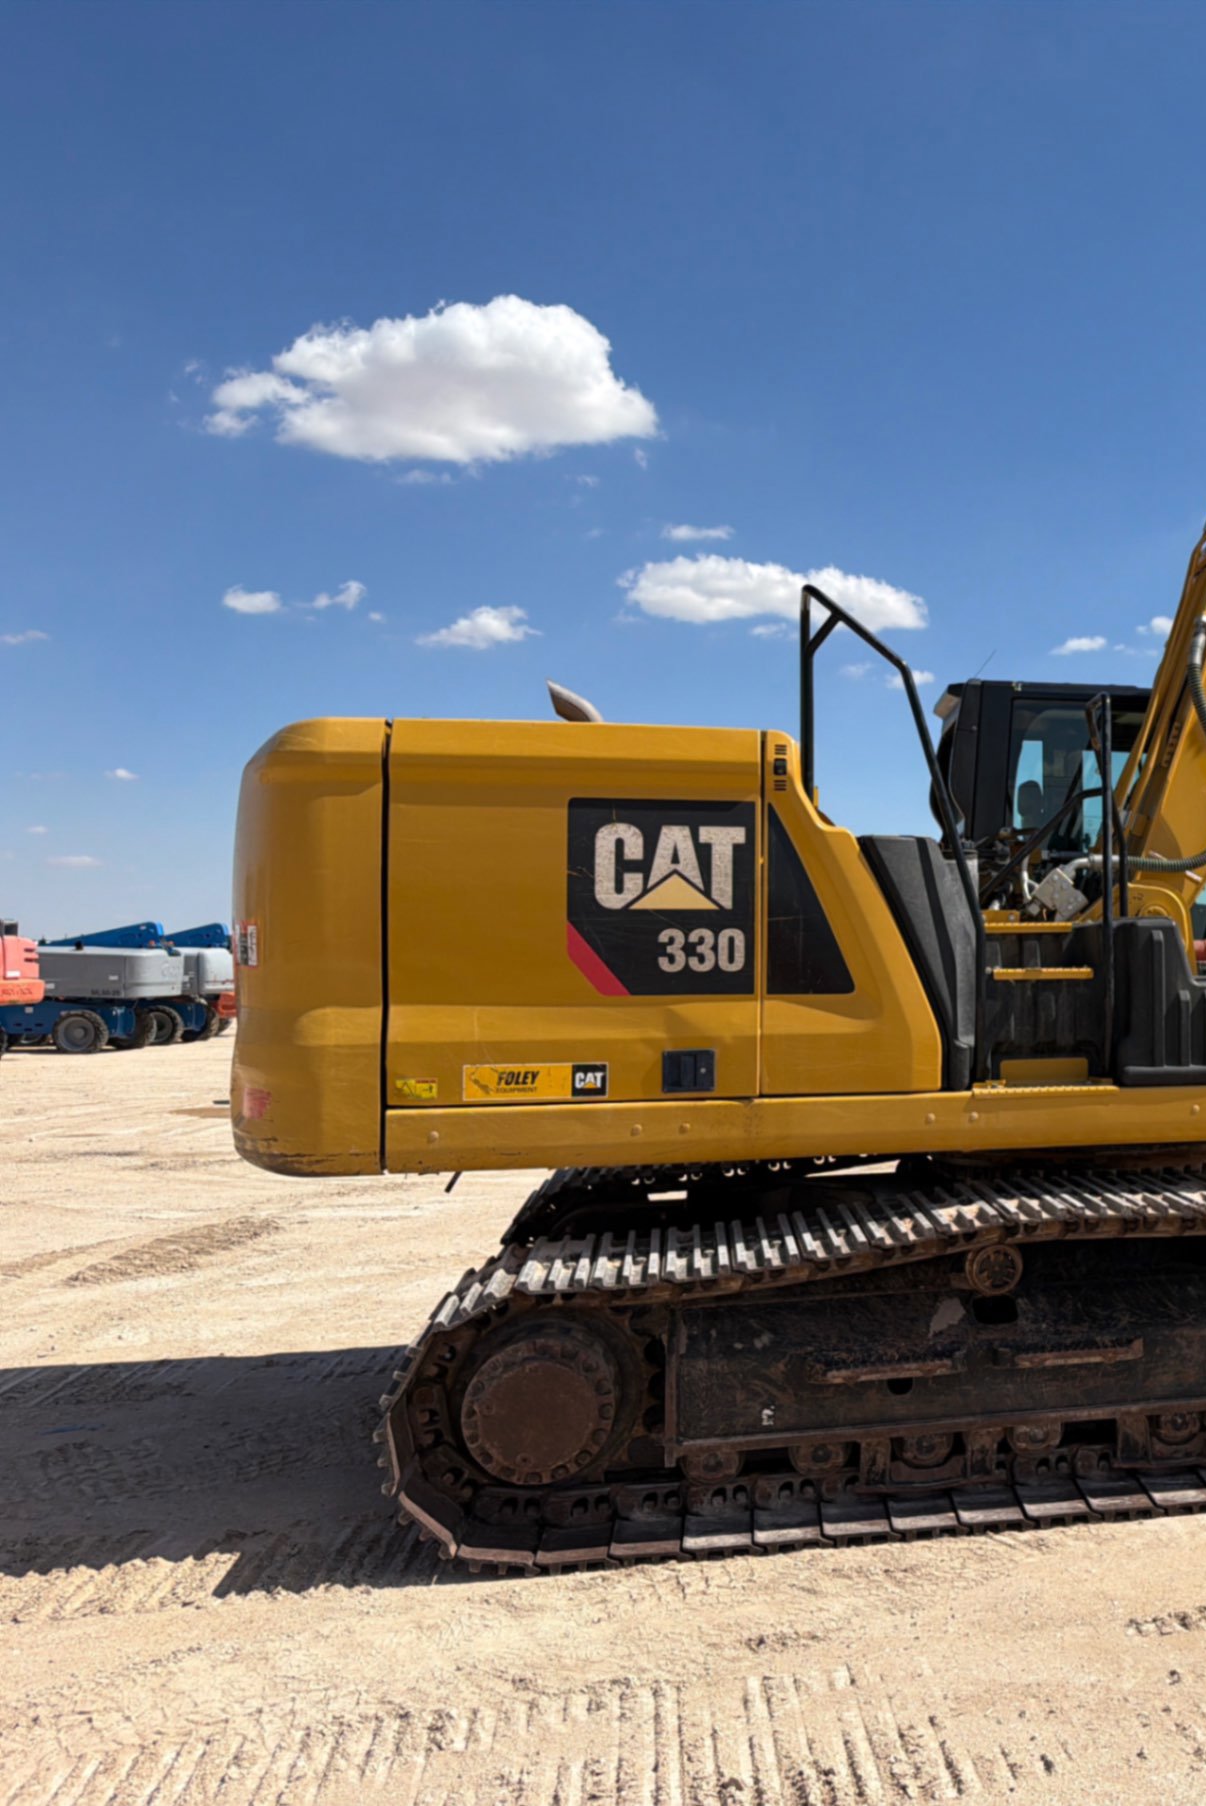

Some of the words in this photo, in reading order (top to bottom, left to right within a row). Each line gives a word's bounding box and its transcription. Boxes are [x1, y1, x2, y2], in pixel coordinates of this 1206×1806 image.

[594, 822, 746, 910] CAT
[657, 927, 745, 973] 330
[497, 1070, 540, 1086] FOLEY
[574, 1071, 604, 1089] CAT
